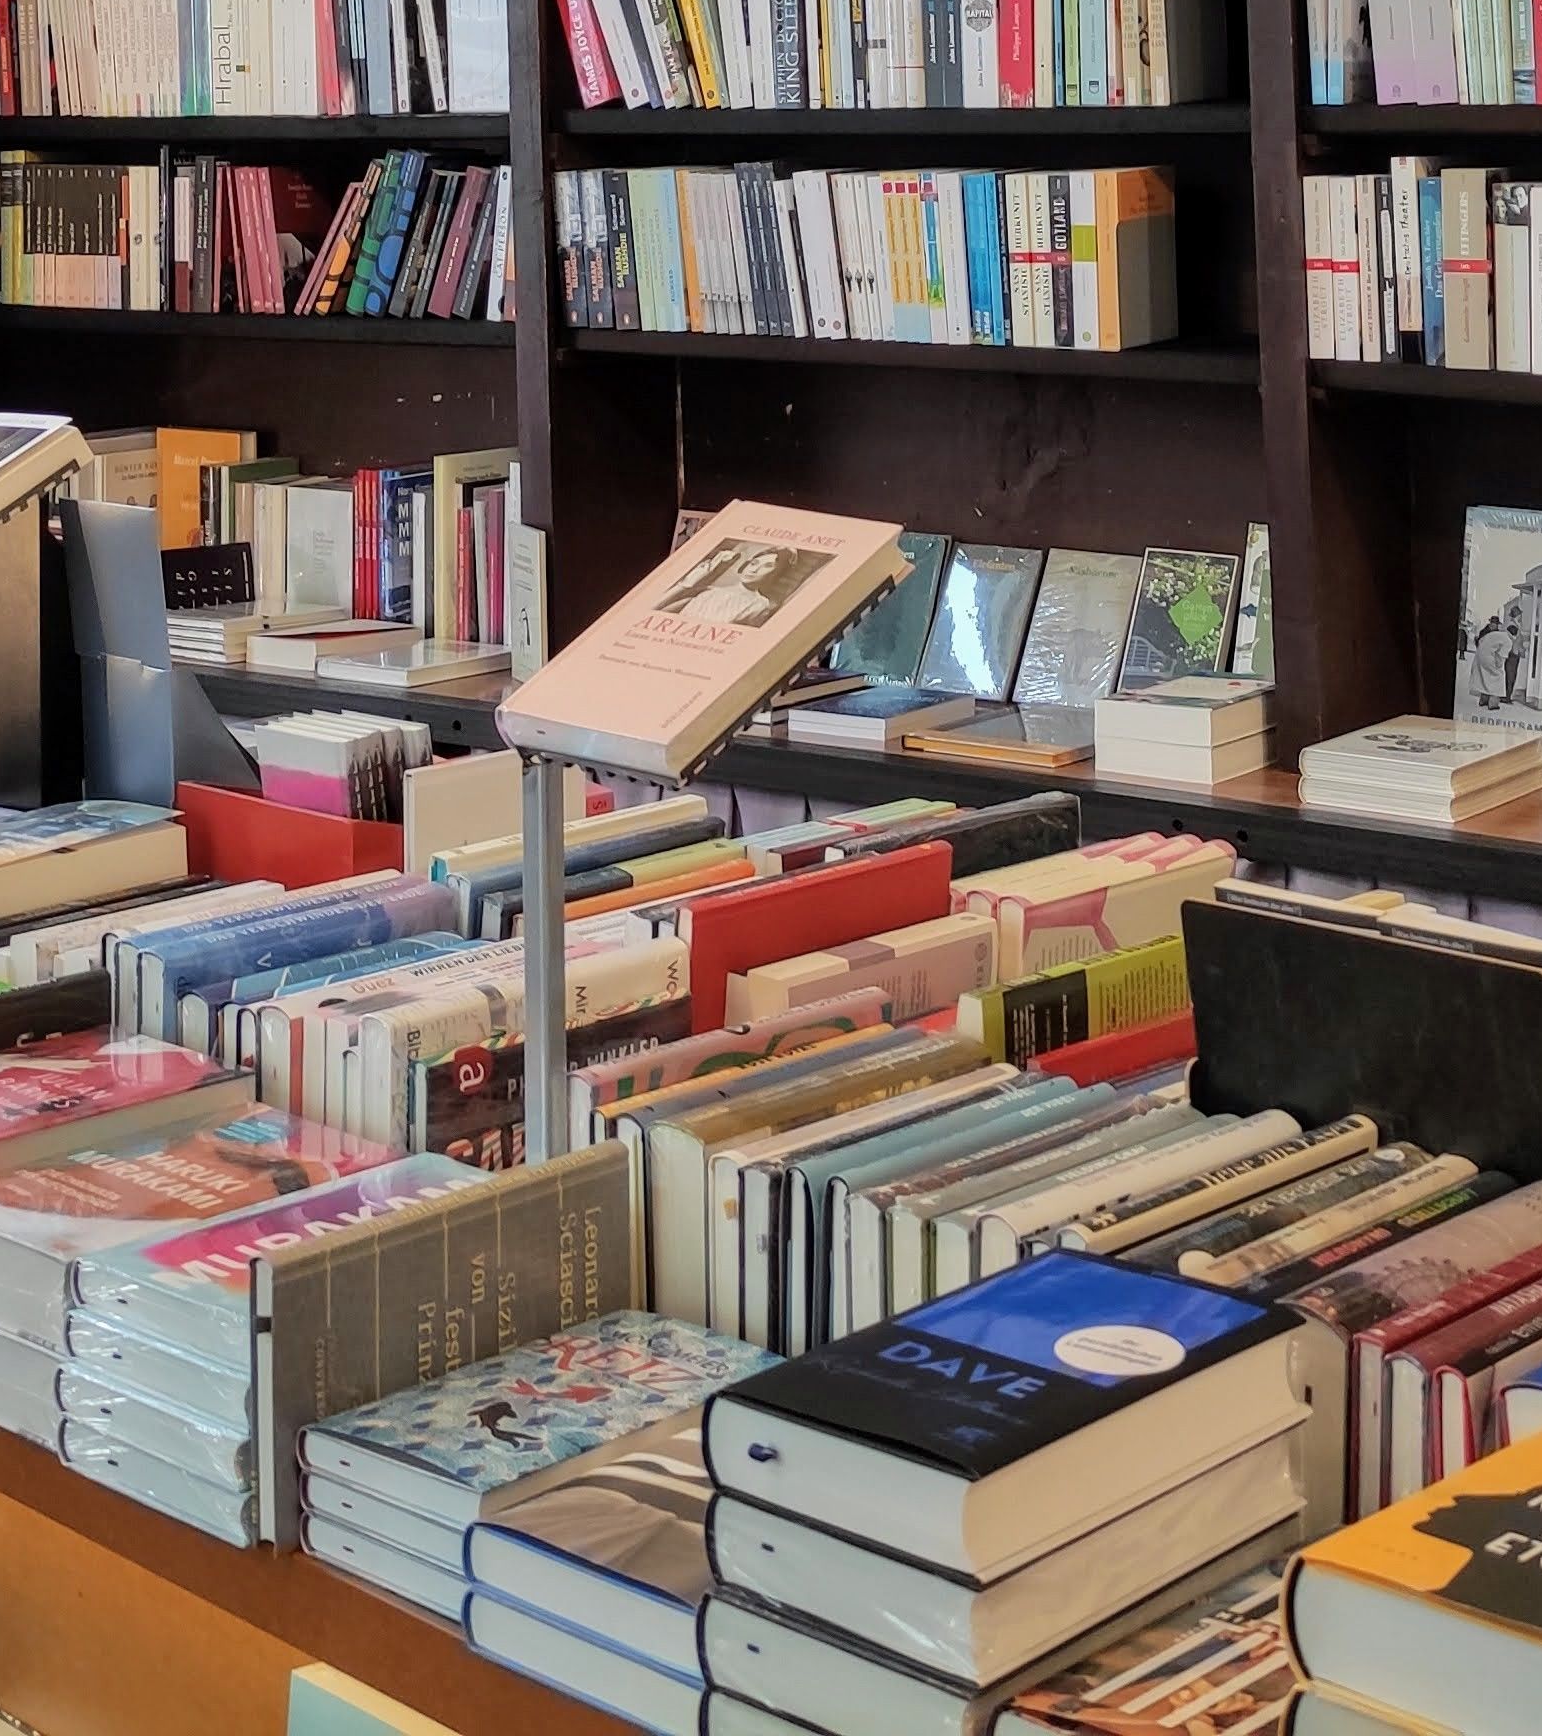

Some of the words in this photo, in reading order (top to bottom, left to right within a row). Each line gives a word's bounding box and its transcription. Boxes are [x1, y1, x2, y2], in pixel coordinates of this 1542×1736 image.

[573, 11, 589, 55] JOYCE
[212, 26, 232, 106] Hrabal
[583, 55, 601, 100] JAMES
[776, 52, 789, 104] STEPHEN
[787, 58, 801, 105] KING
[1052, 197, 1067, 251] GOTLAND
[616, 246, 626, 288] SALMAN
[631, 612, 745, 648] ARIANE
[67, 1147, 226, 1212] MURAKAMI
[133, 1147, 248, 1196] HARUKI
[469, 1252, 487, 1306] von
[878, 1340, 1049, 1400] DAVE
